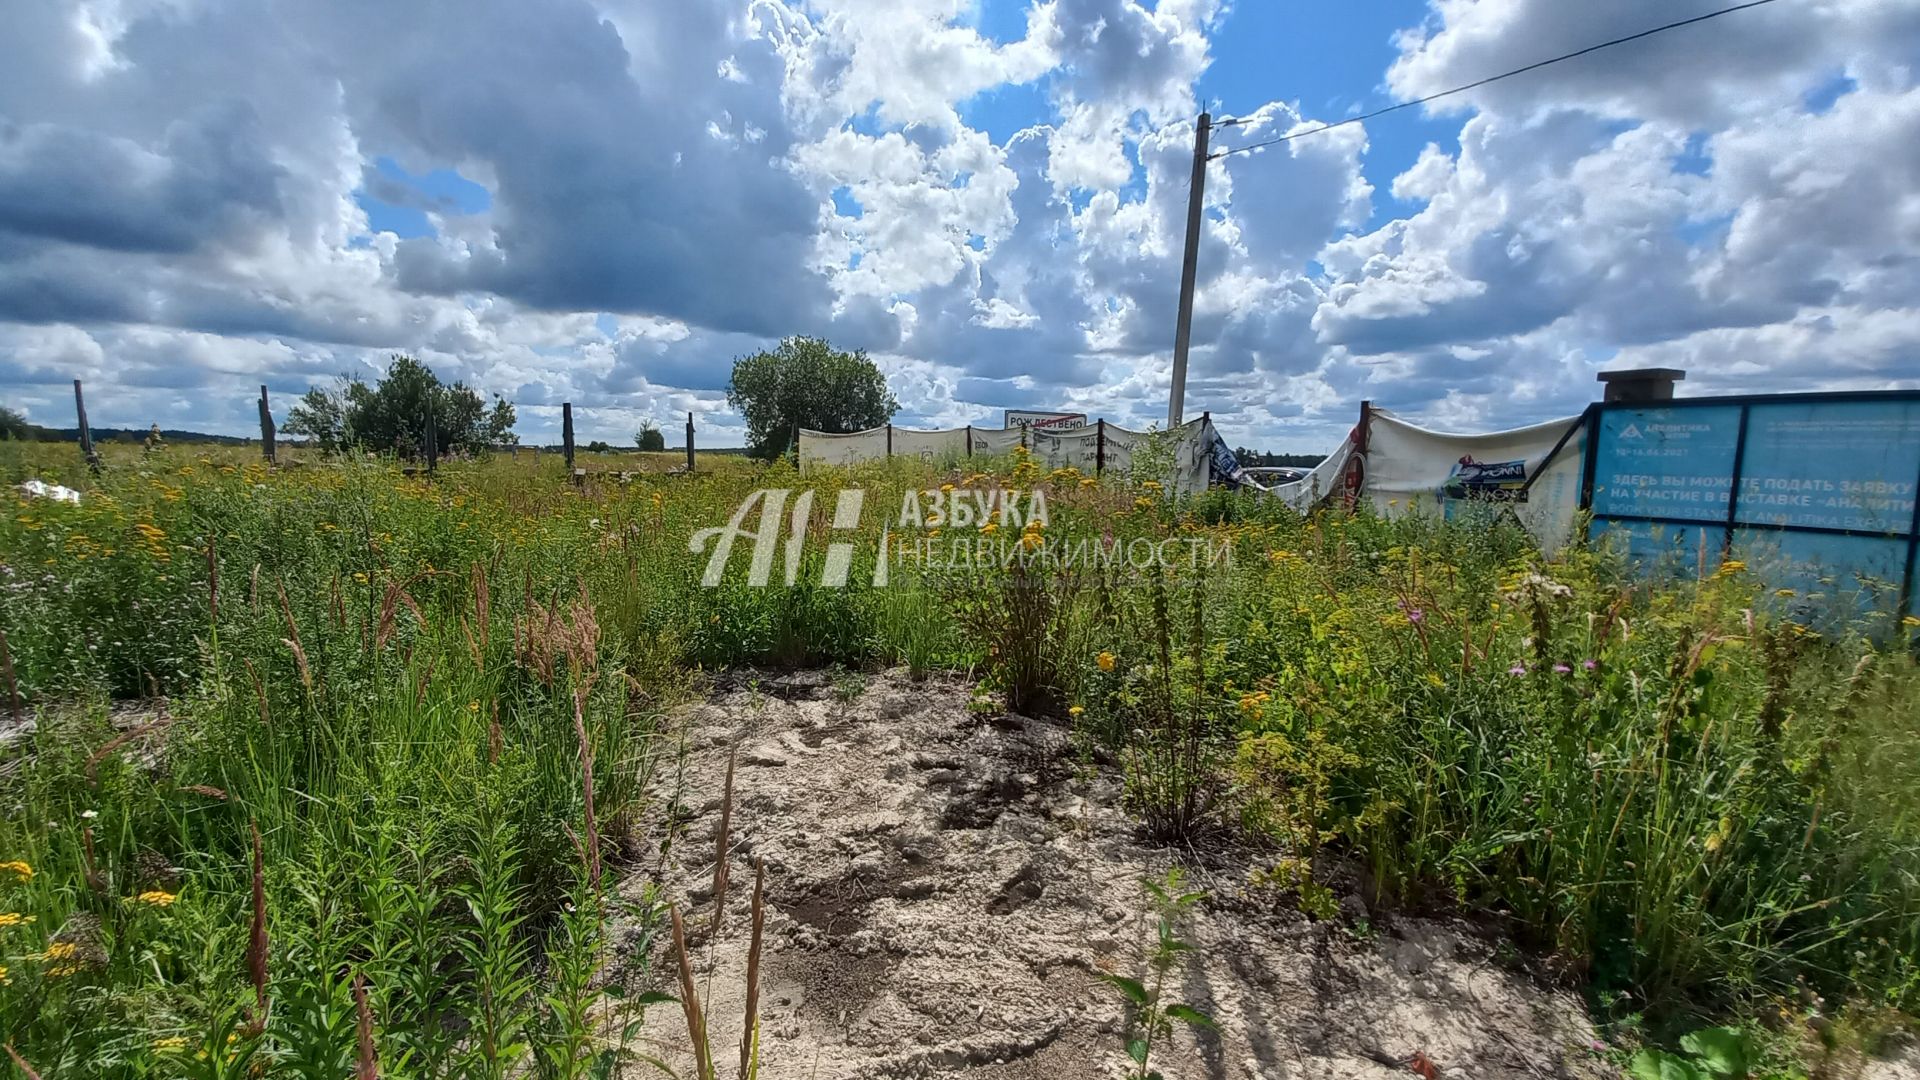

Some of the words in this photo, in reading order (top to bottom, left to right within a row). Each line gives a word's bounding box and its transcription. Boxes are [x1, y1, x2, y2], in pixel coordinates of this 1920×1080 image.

[1010, 416, 1083, 429] РОЖДЕСТВЕНО
[1613, 474, 1658, 486] ЗДЕСЬ
[1662, 476, 1684, 487] ВЫ
[1690, 477, 1760, 489] МОЖТЕ
[1764, 478, 1834, 491] ПОДАТЬ
[1839, 480, 1912, 495] ЗАЯВКУ
[1611, 488, 1629, 498] НА
[1634, 489, 1699, 501] УЧАСТИЕ
[1705, 492, 1715, 502] В
[1609, 503, 1645, 514] BOOK
[1646, 505, 1680, 517] YOUR
